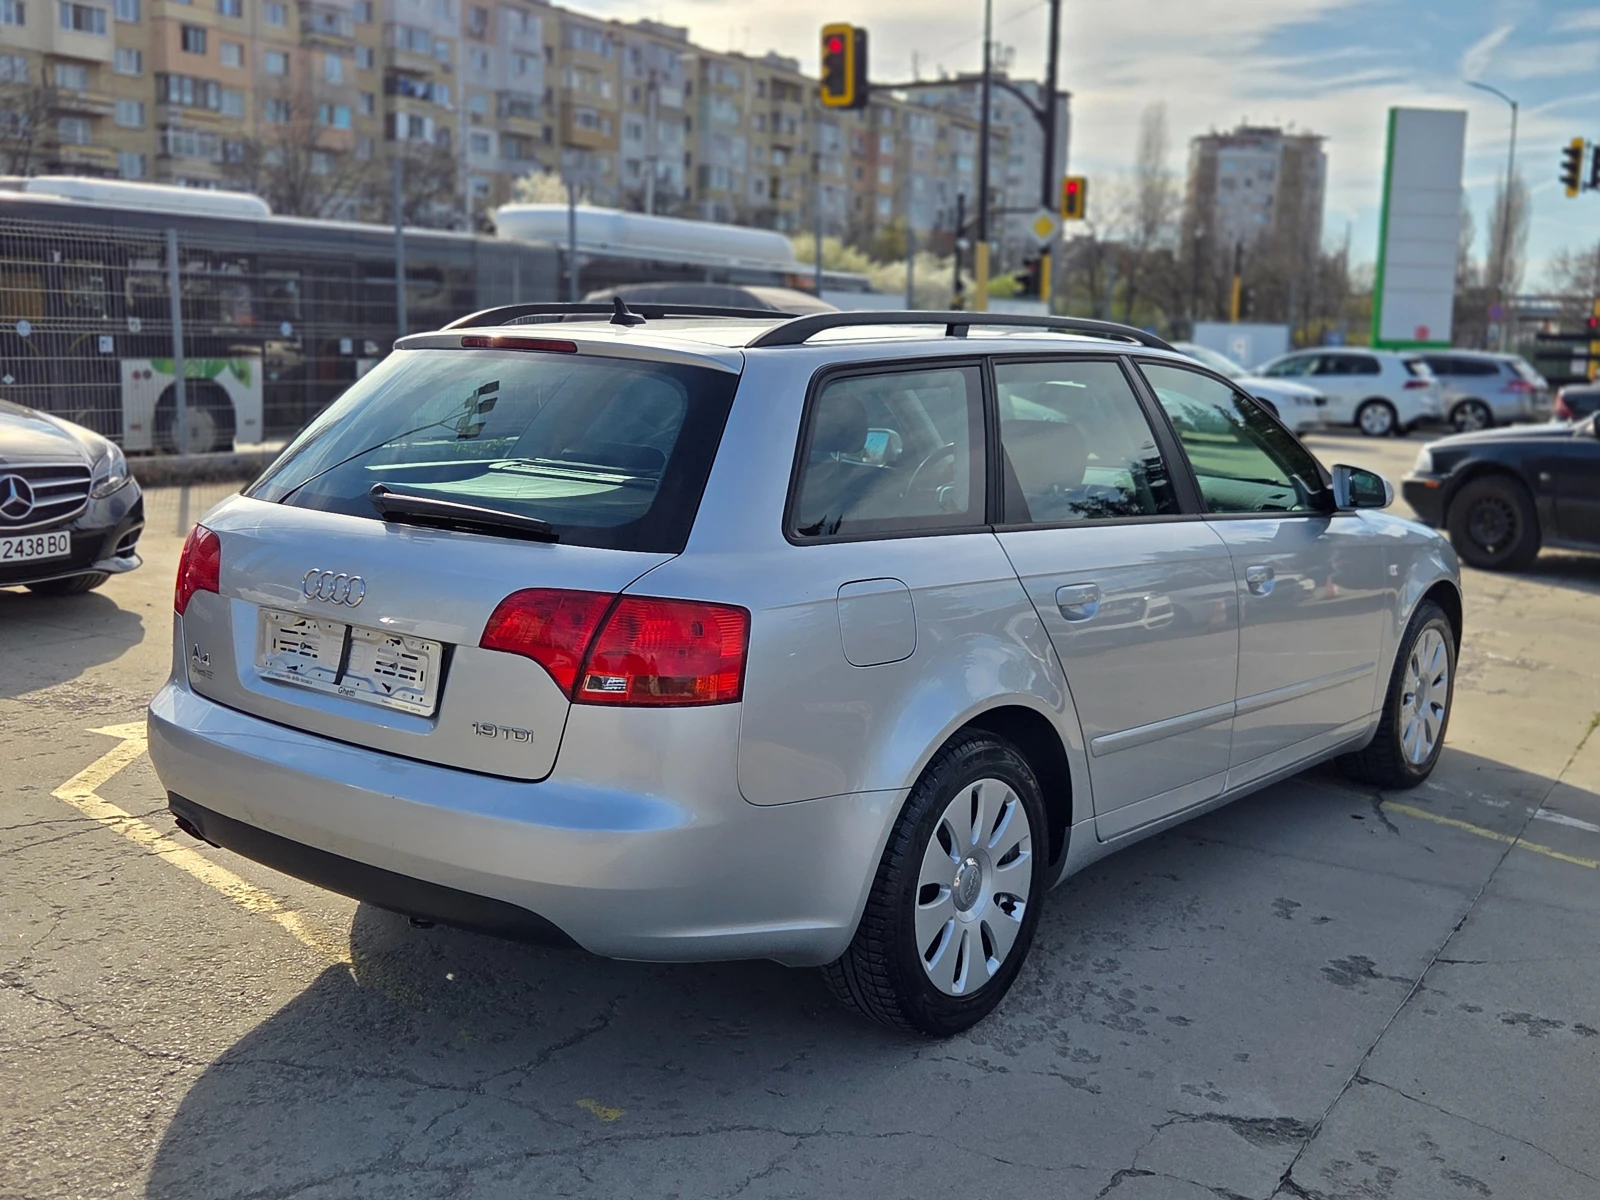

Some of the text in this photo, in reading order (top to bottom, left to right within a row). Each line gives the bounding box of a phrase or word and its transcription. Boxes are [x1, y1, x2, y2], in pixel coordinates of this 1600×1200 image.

[2, 537, 45, 559] 2438
[191, 643, 211, 667] A4
[498, 725, 534, 745] TDI
